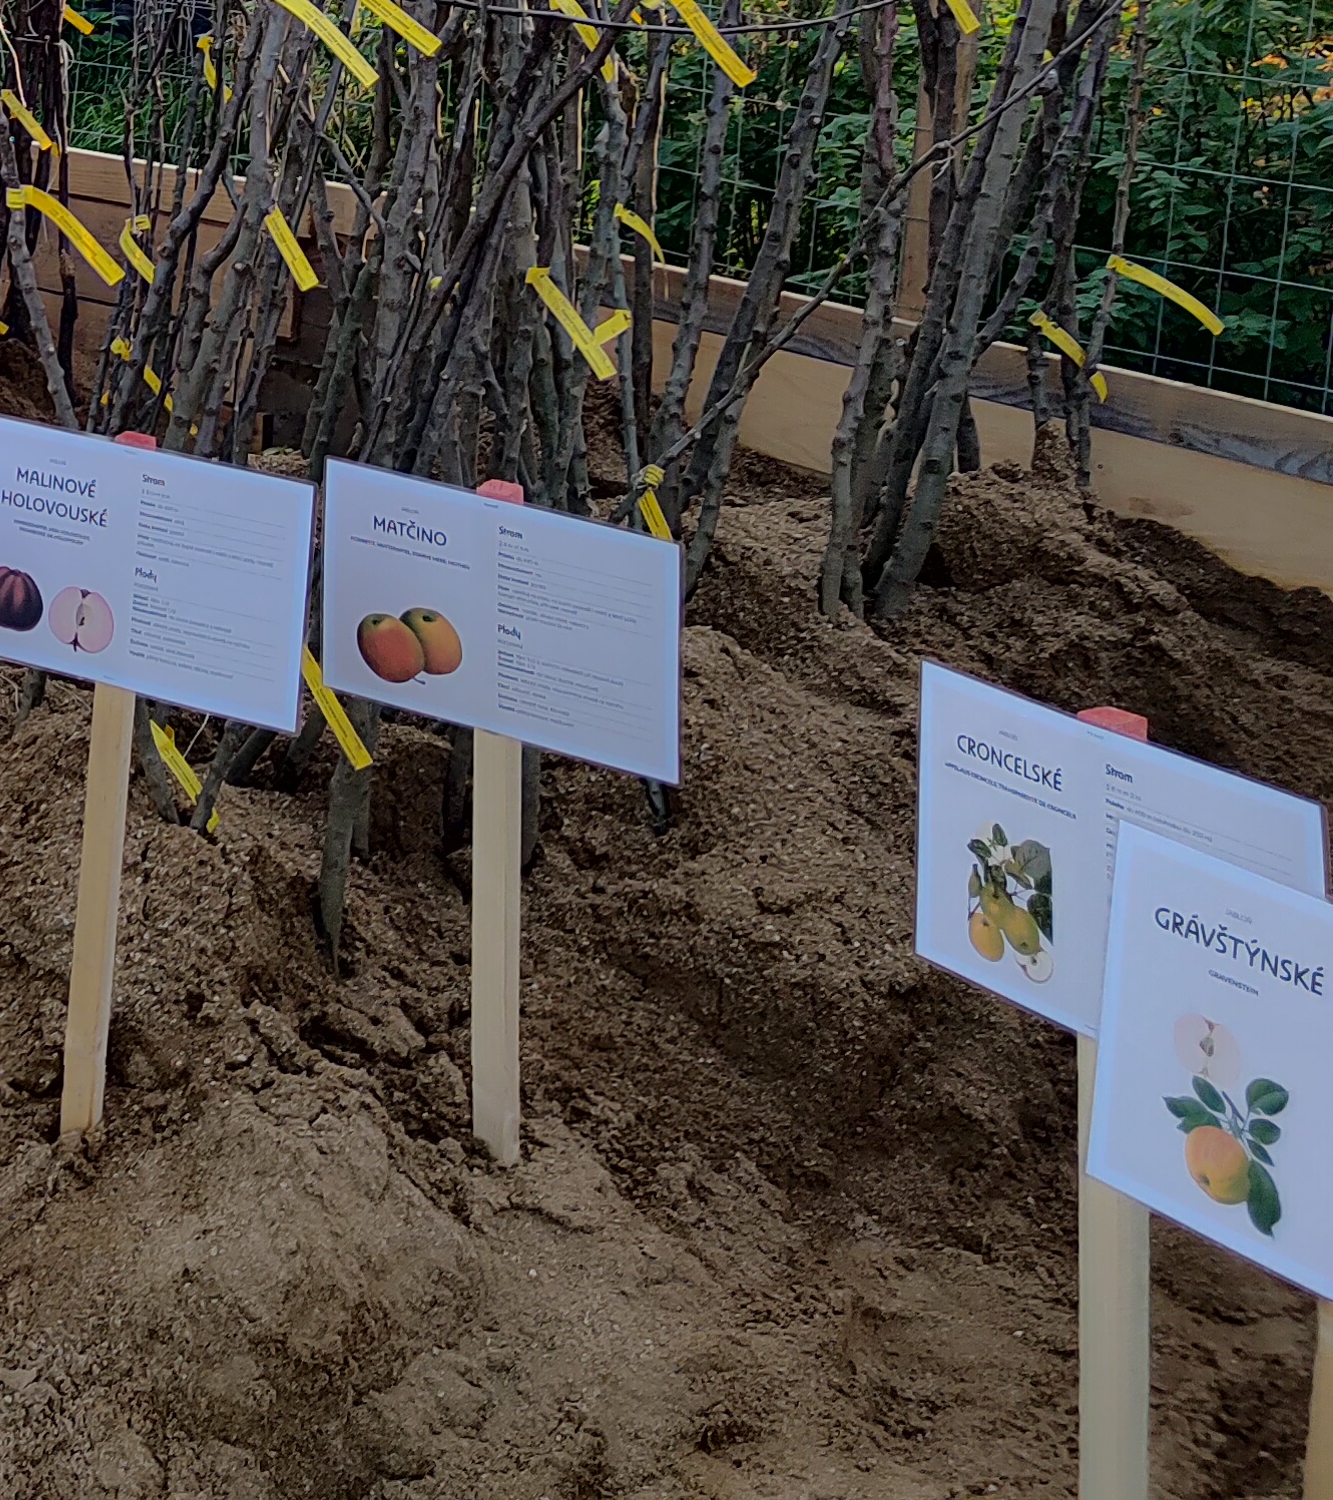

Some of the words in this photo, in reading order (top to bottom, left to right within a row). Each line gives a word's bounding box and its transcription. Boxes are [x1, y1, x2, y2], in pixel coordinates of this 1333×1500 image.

[16, 466, 96, 498] MALINOVÉ
[1, 489, 108, 528] HOLOVOUSKÉ
[373, 515, 447, 546] MATČINO
[498, 525, 523, 540] Strom
[497, 623, 521, 641] Plody
[956, 734, 1063, 792] CRONCELSKÉ
[1105, 763, 1134, 784] Strom
[1154, 907, 1325, 997] GRÁVŠTÝNSKÉ
